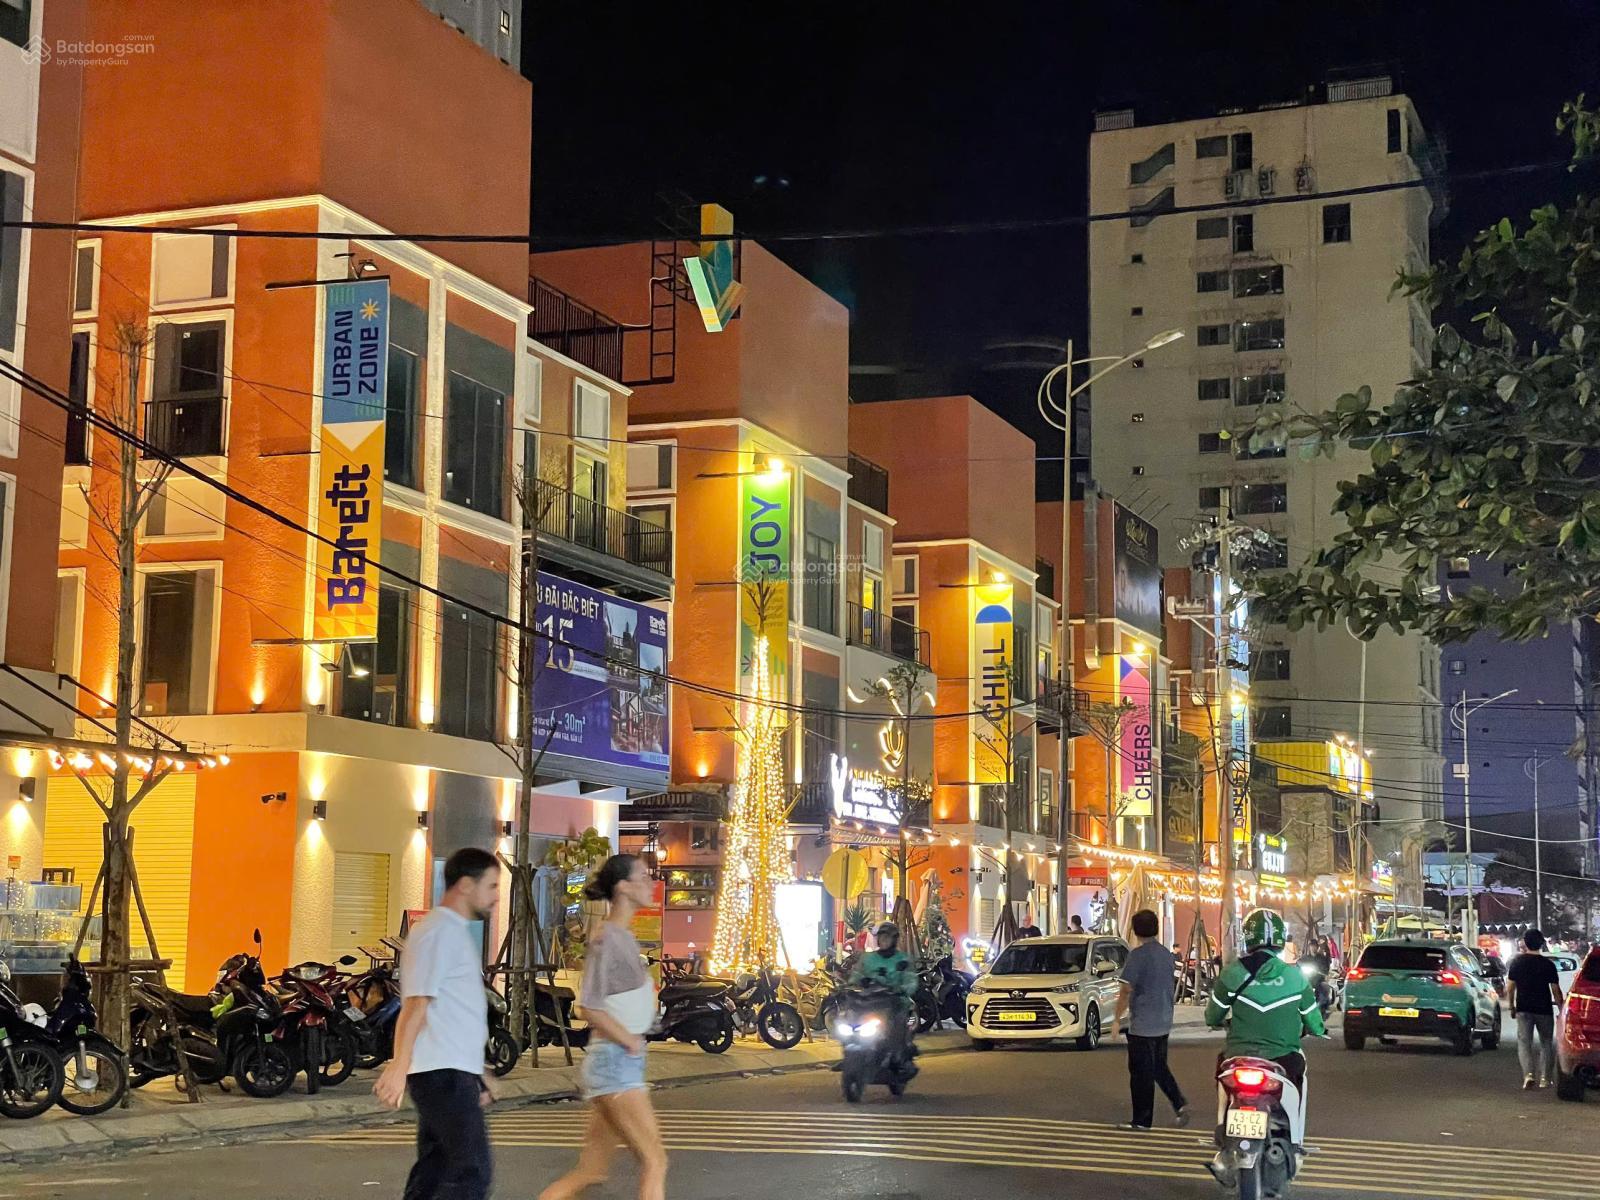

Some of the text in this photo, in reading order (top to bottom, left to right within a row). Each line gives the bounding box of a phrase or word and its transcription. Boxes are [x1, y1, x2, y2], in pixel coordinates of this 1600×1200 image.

[332, 310, 353, 397] URBAN
[358, 326, 379, 395] ZONE
[325, 463, 371, 612] Barett
[750, 495, 782, 575] JOY
[545, 585, 560, 609] ĐÃI
[581, 596, 600, 623] BIỆT
[982, 638, 1006, 722] CHILL
[1134, 724, 1152, 800] CHEERS
